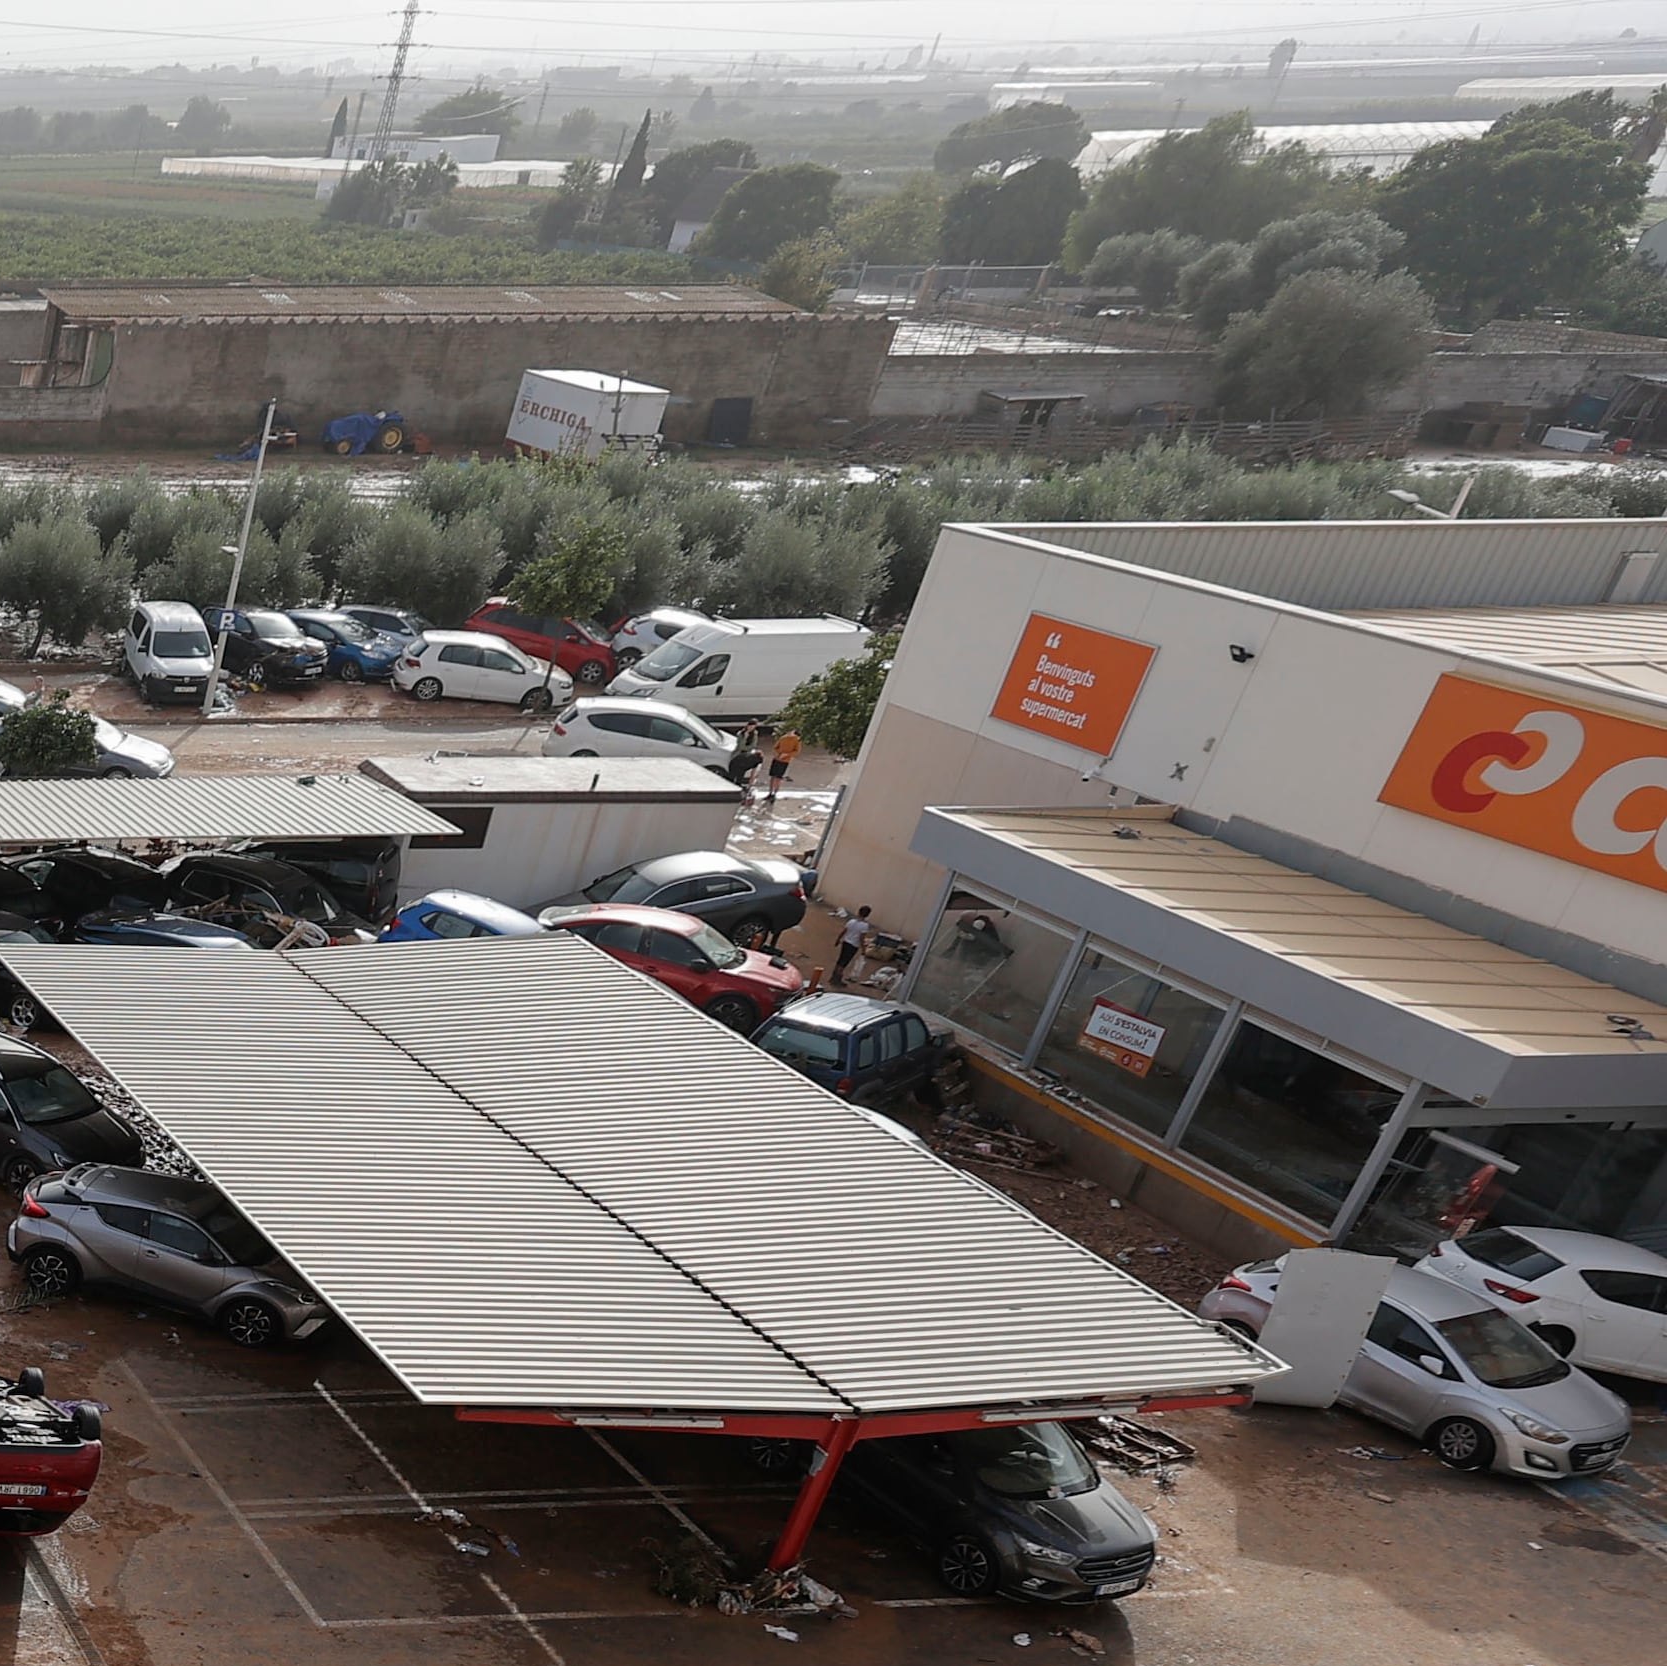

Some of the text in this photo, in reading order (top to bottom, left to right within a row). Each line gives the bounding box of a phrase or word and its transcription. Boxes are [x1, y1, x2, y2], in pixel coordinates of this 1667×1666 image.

[1035, 654, 1096, 688] Benvinguts
[1028, 675, 1075, 704] al vostre
[1020, 697, 1087, 730] supermercat
[1098, 1025, 1149, 1050] EN CONSUM!
